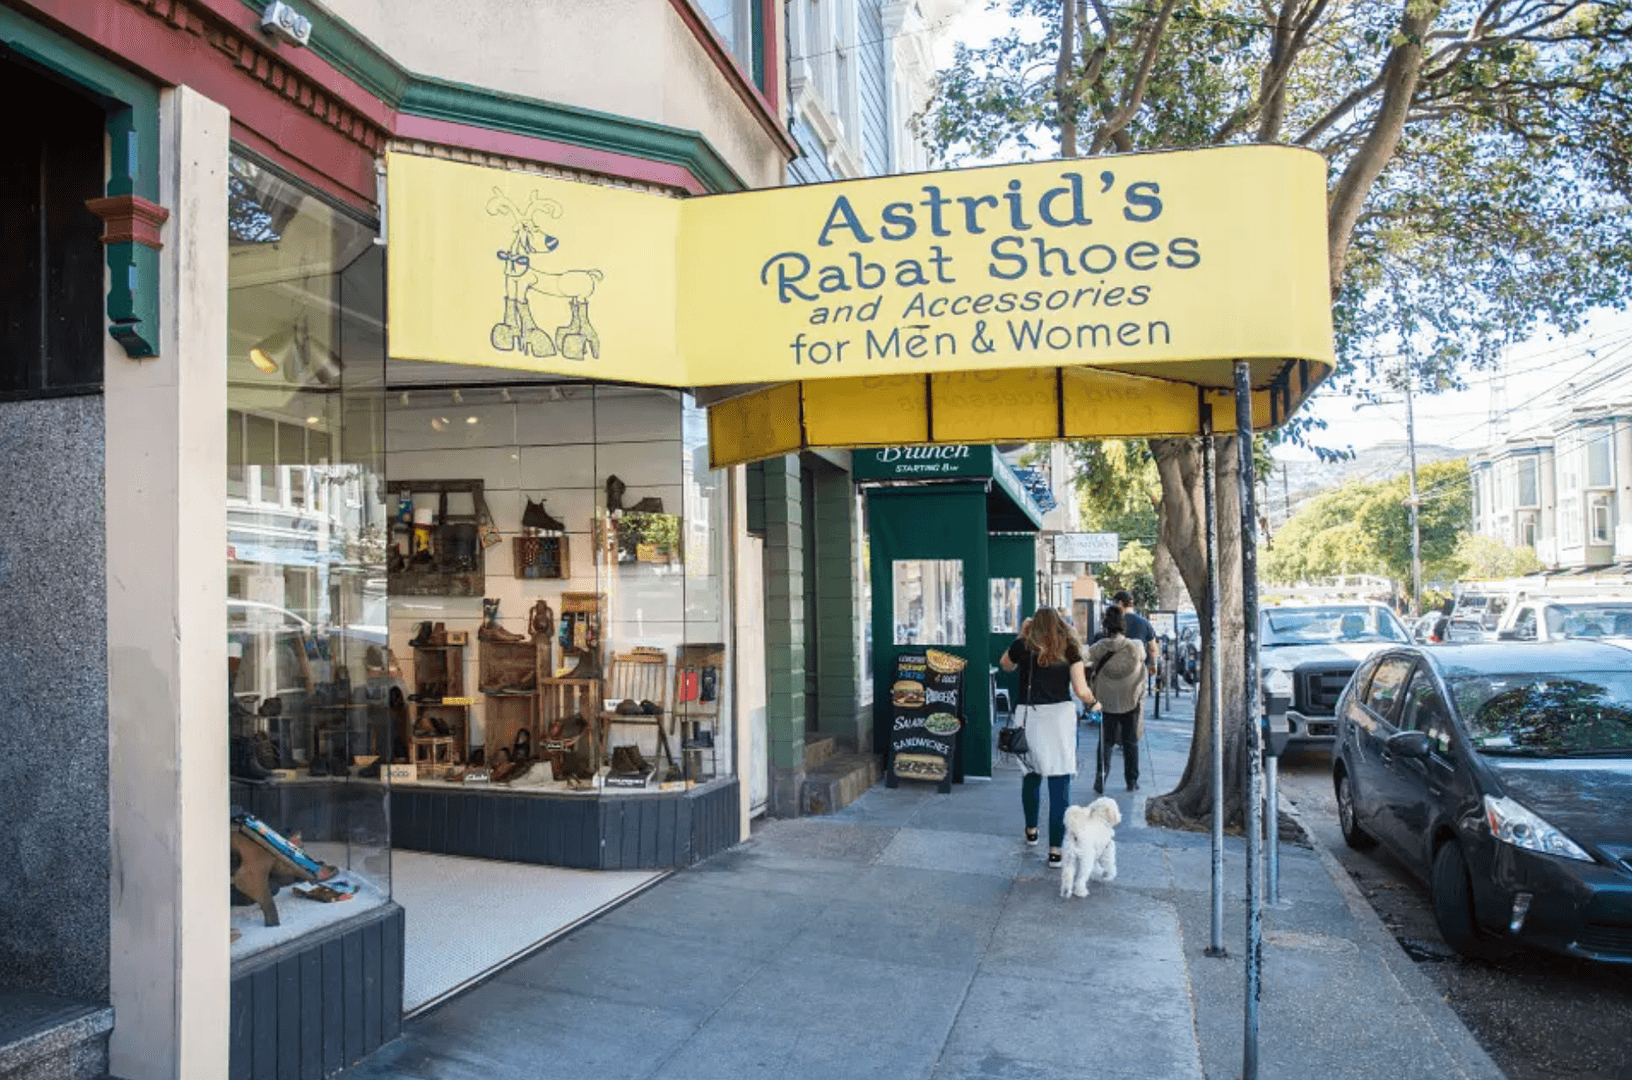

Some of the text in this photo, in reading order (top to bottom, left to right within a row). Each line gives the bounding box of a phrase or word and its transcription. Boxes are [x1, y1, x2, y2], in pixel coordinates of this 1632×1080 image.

[817, 170, 1163, 246] Astrid's
[761, 235, 1201, 304] Rabat Shoes
[809, 280, 1152, 326] and Accessories
[791, 334, 850, 365] for
[971, 319, 996, 354] &
[1007, 319, 1170, 352] Women
[876, 444, 970, 463] Brunch
[895, 464, 941, 473] STARTING
